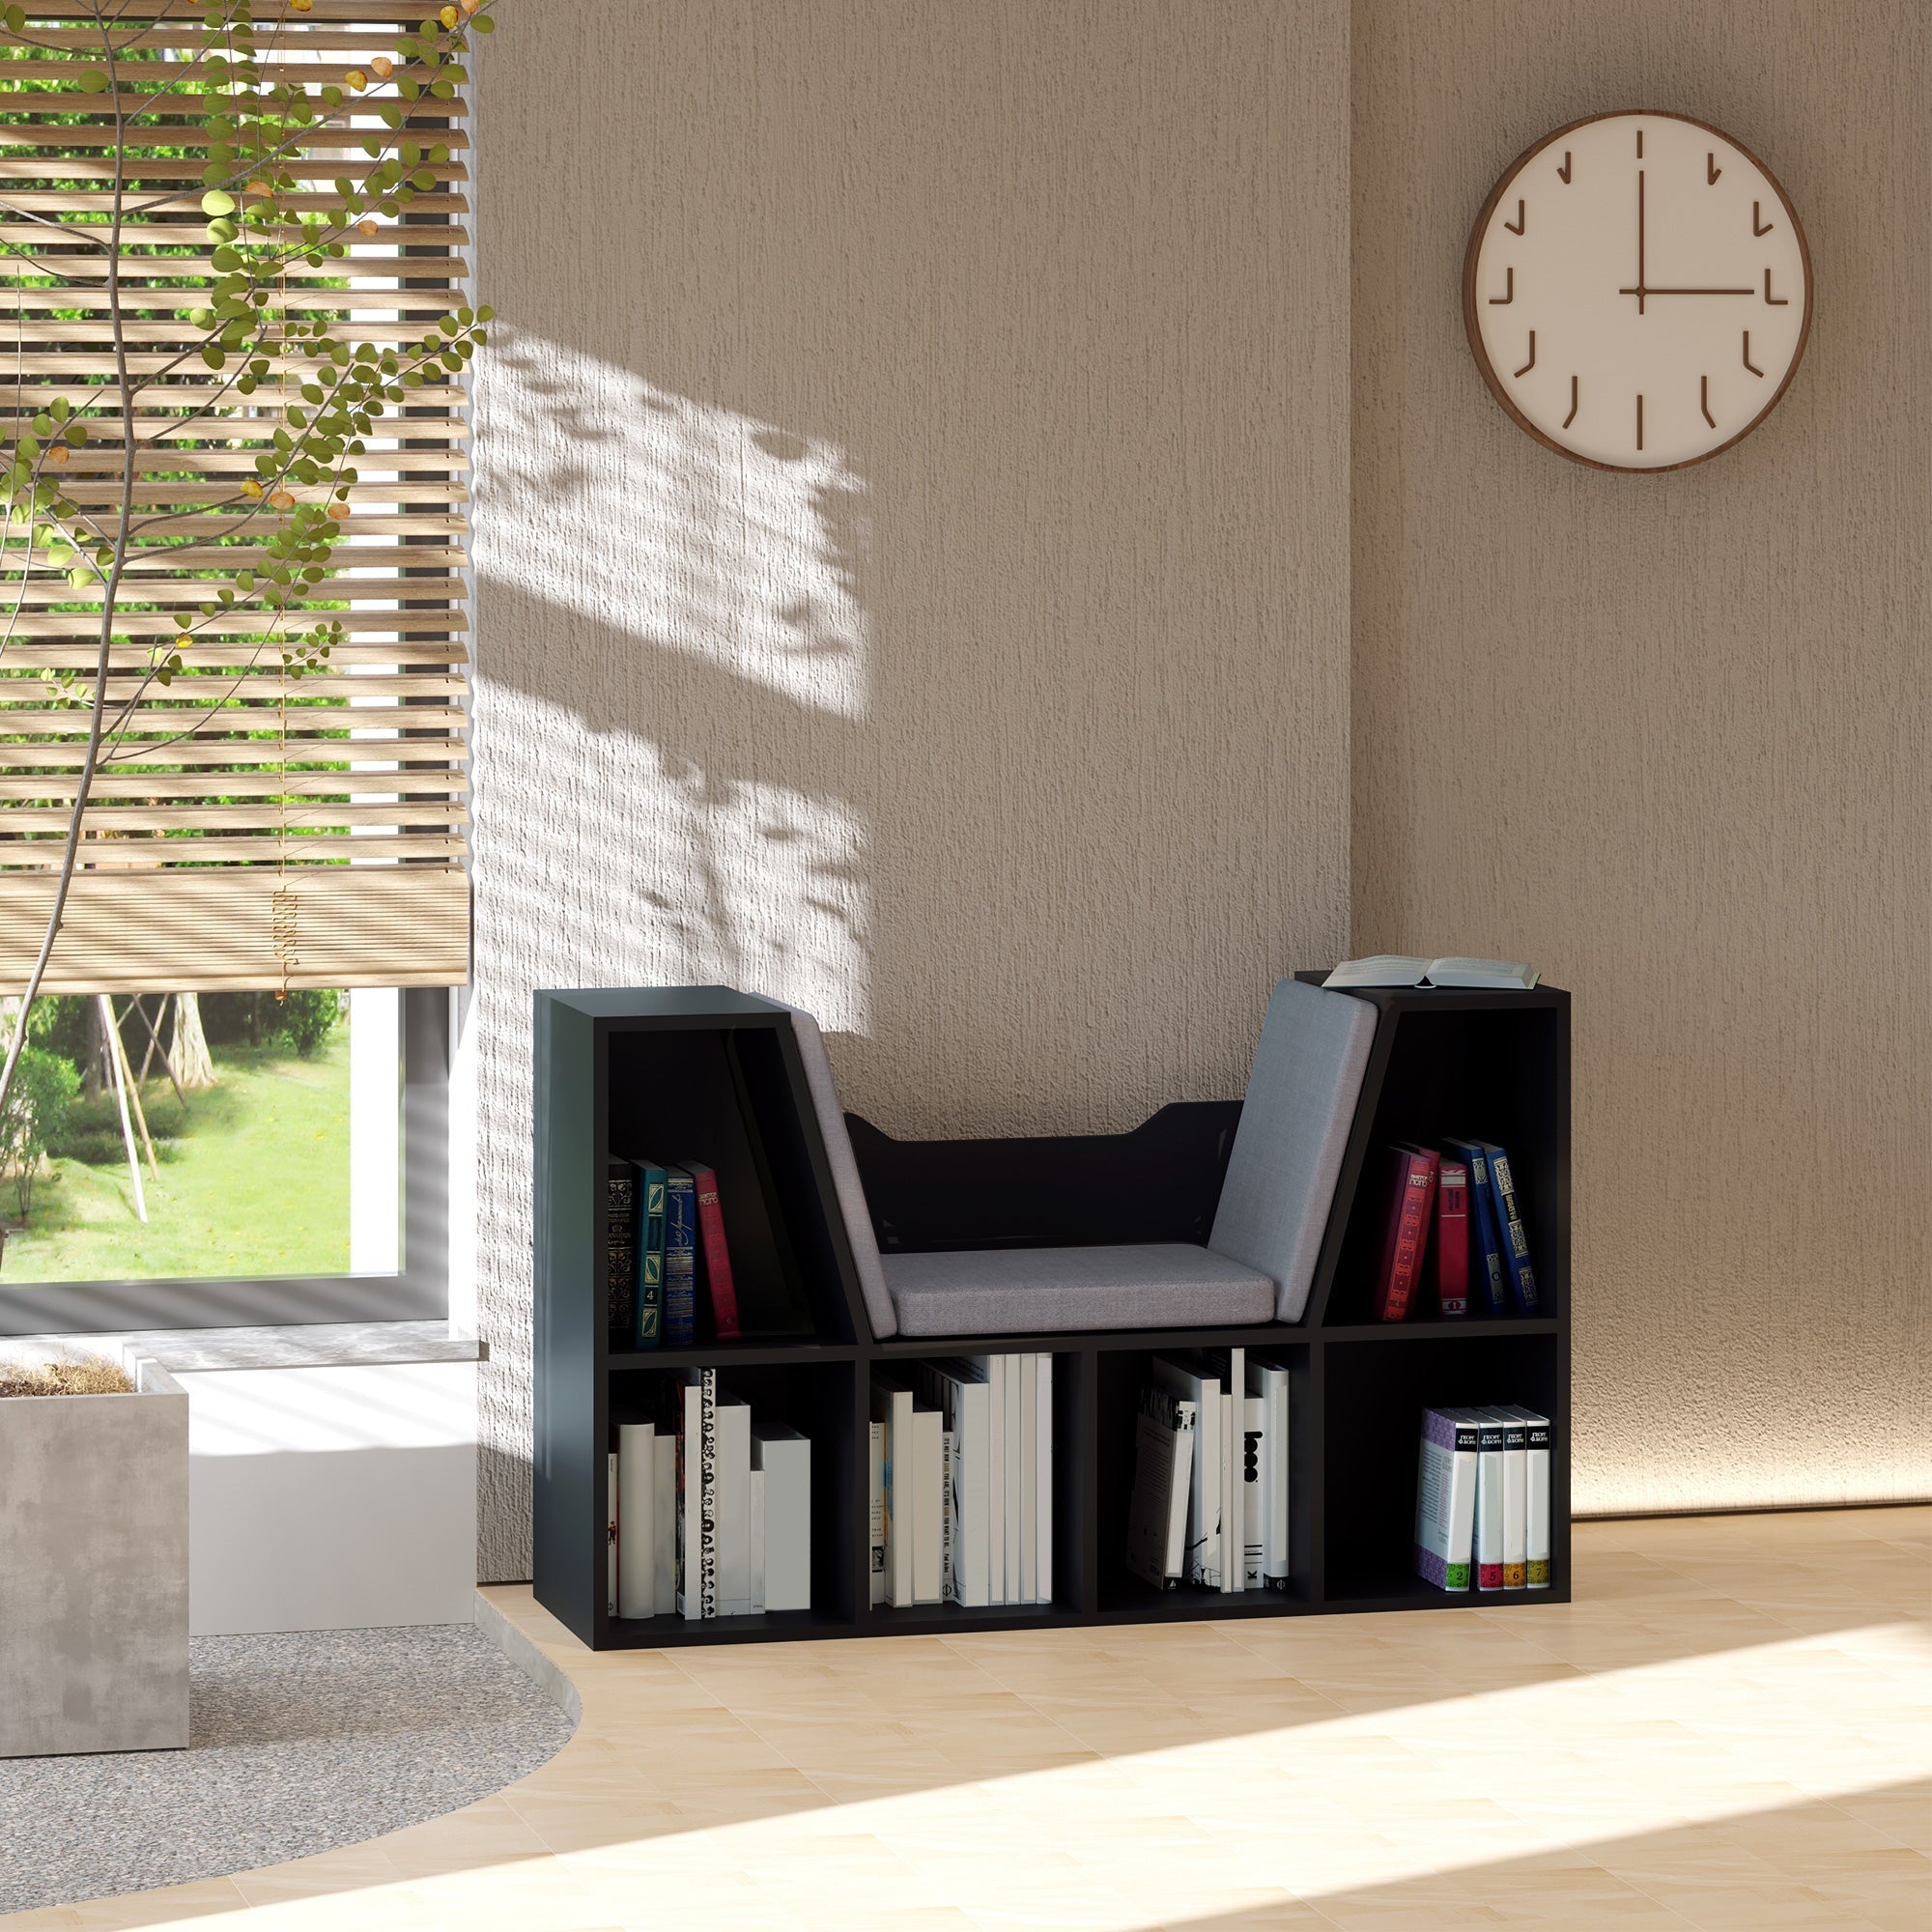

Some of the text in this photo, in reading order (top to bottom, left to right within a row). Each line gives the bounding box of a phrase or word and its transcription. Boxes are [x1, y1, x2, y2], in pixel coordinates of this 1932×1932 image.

[646, 1291, 654, 1300] 4
[1456, 1571, 1463, 1581] 2
[1489, 1571, 1496, 1581] 5
[1513, 1570, 1520, 1580] 6
[1536, 1568, 1543, 1577] 7
